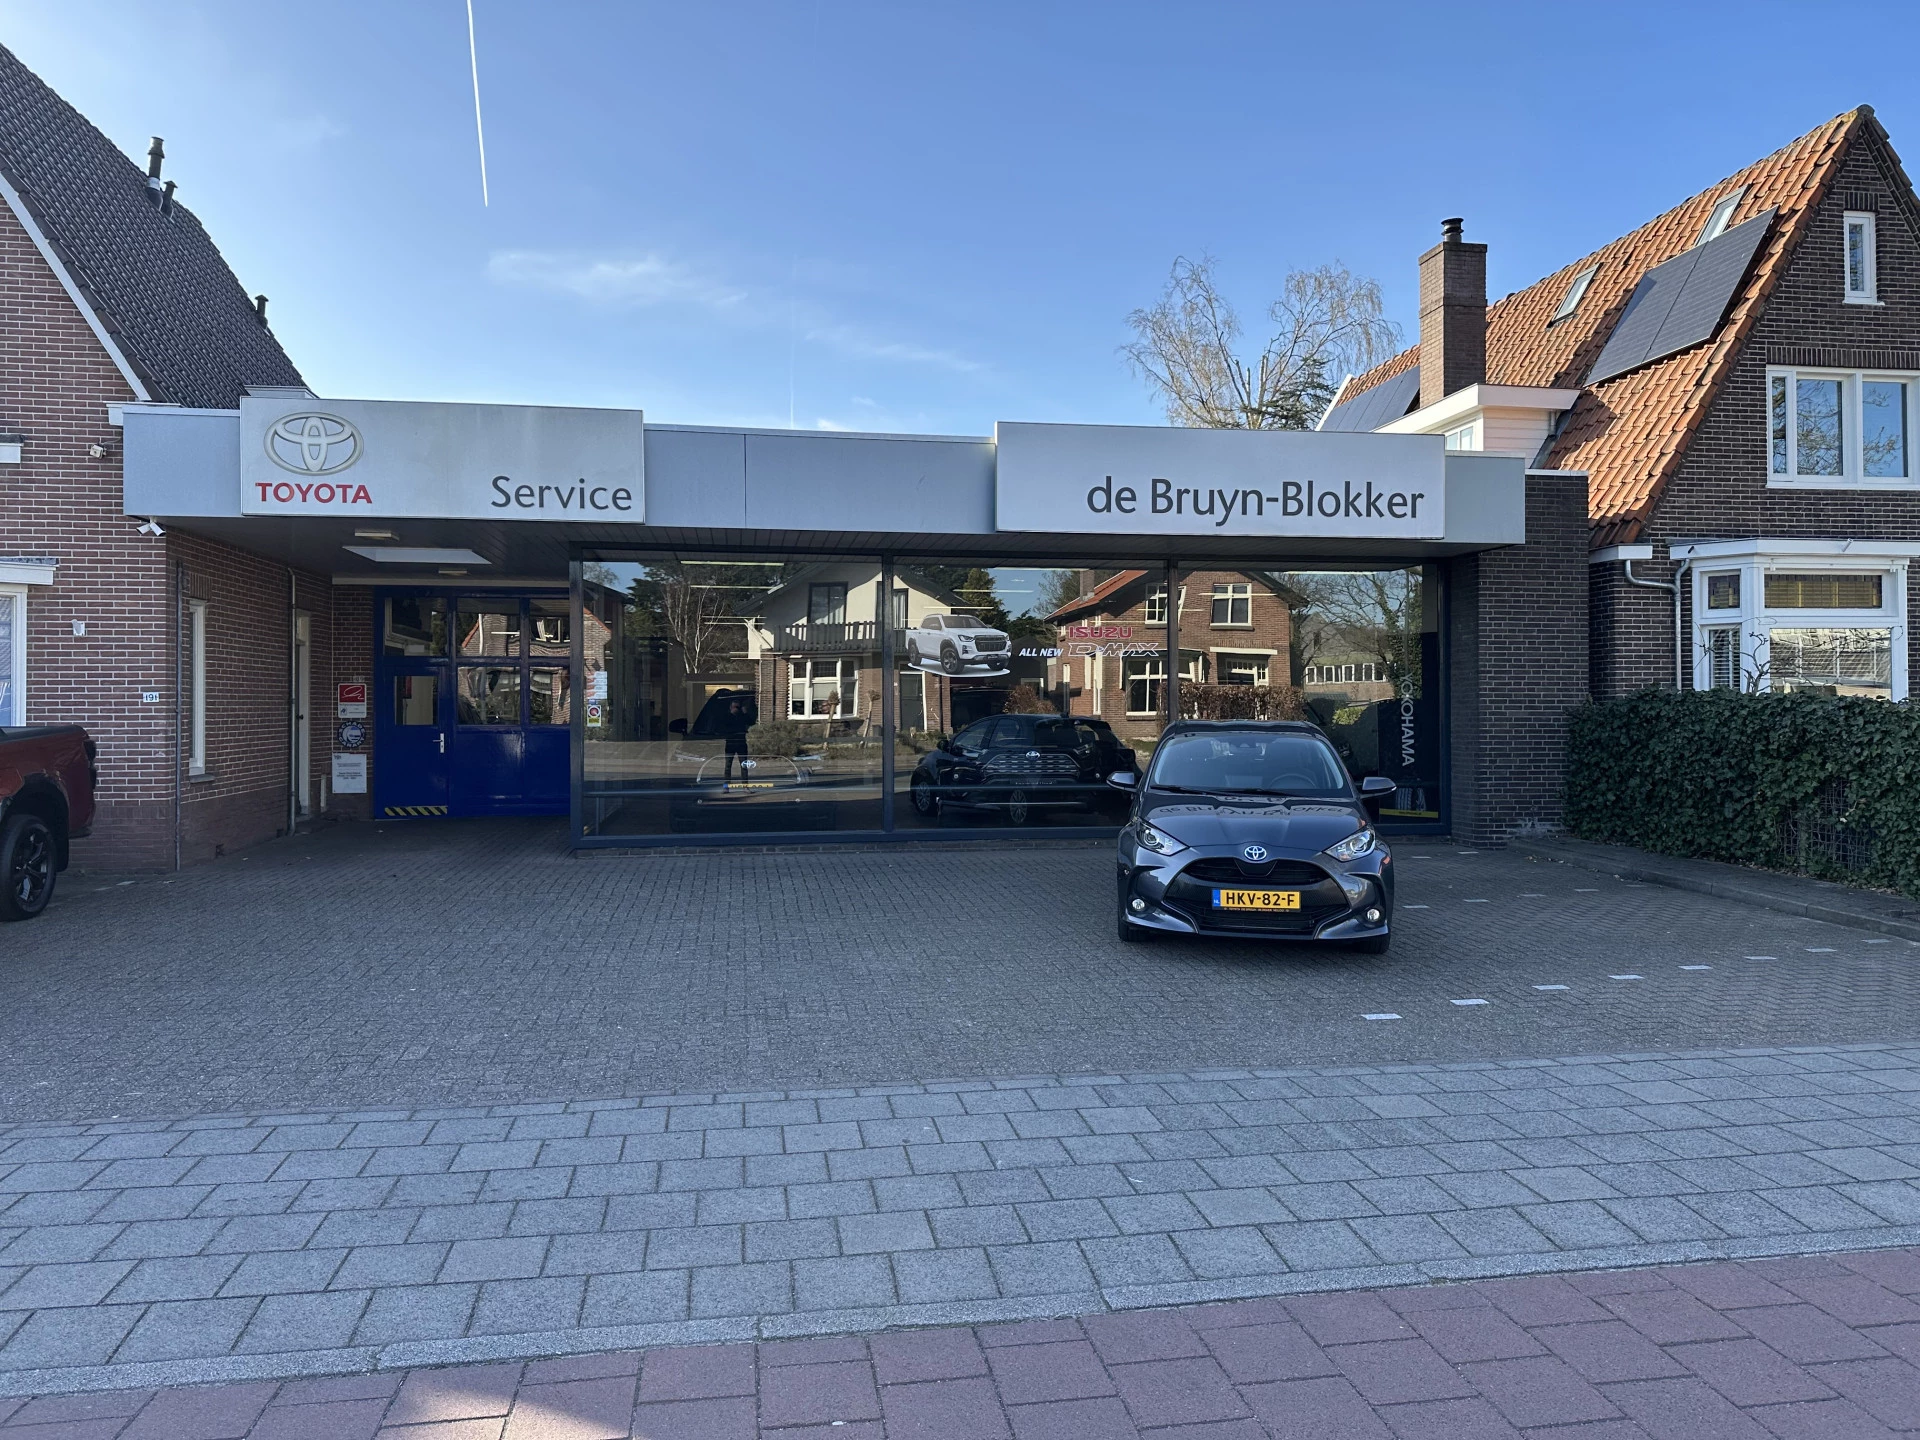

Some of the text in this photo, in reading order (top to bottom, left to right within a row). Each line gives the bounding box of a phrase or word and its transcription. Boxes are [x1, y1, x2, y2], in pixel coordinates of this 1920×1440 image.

[255, 482, 373, 504] TOYOTA
[490, 475, 633, 511] Service
[1086, 476, 1425, 527] de Bruyn-Blokker
[1068, 626, 1133, 639] ISUZU
[1019, 648, 1063, 657] ALL NEW
[1400, 673, 1415, 767] YOKOHAMA
[1226, 892, 1295, 907] HKV-82-F
